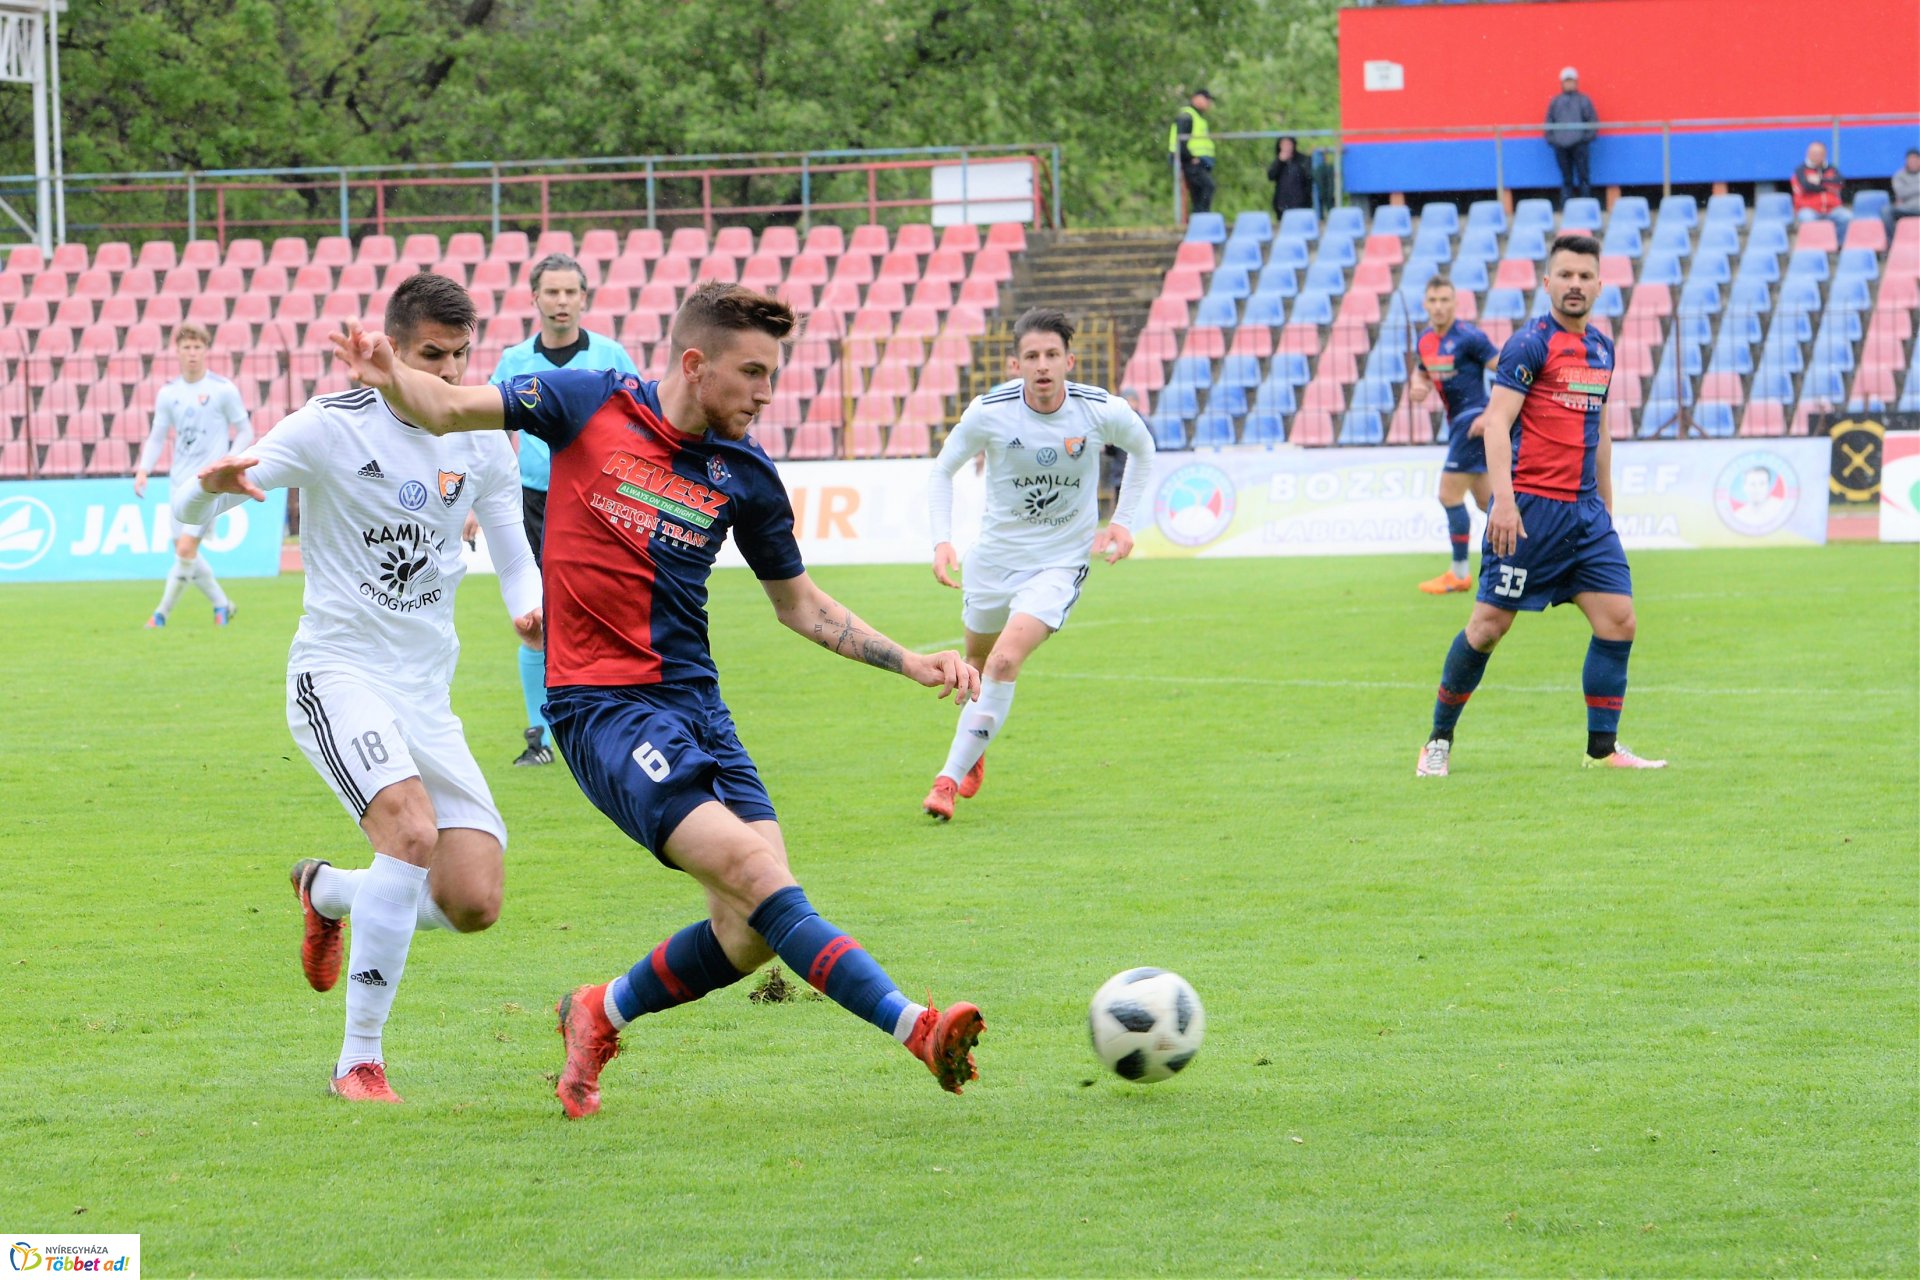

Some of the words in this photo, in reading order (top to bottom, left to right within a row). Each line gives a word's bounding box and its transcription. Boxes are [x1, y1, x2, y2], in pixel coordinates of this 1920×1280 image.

[357, 470, 384, 479] adidas
[1012, 474, 1080, 491] KAMILLA
[1269, 470, 1440, 502] BOZSI
[590, 493, 660, 530] LERTON
[661, 520, 710, 548] TRANS
[620, 485, 649, 502] ALWAYS
[649, 495, 660, 505] ON
[661, 501, 674, 511] THE
[674, 506, 695, 520] RIGHT
[695, 514, 711, 526] WAY
[363, 523, 446, 557] KAMILLA
[1263, 512, 1450, 544] LABDARÚG
[359, 582, 443, 613] GYOGYFURD
[1494, 564, 1528, 598] 33
[351, 730, 389, 772] 18
[632, 741, 670, 783] 6
